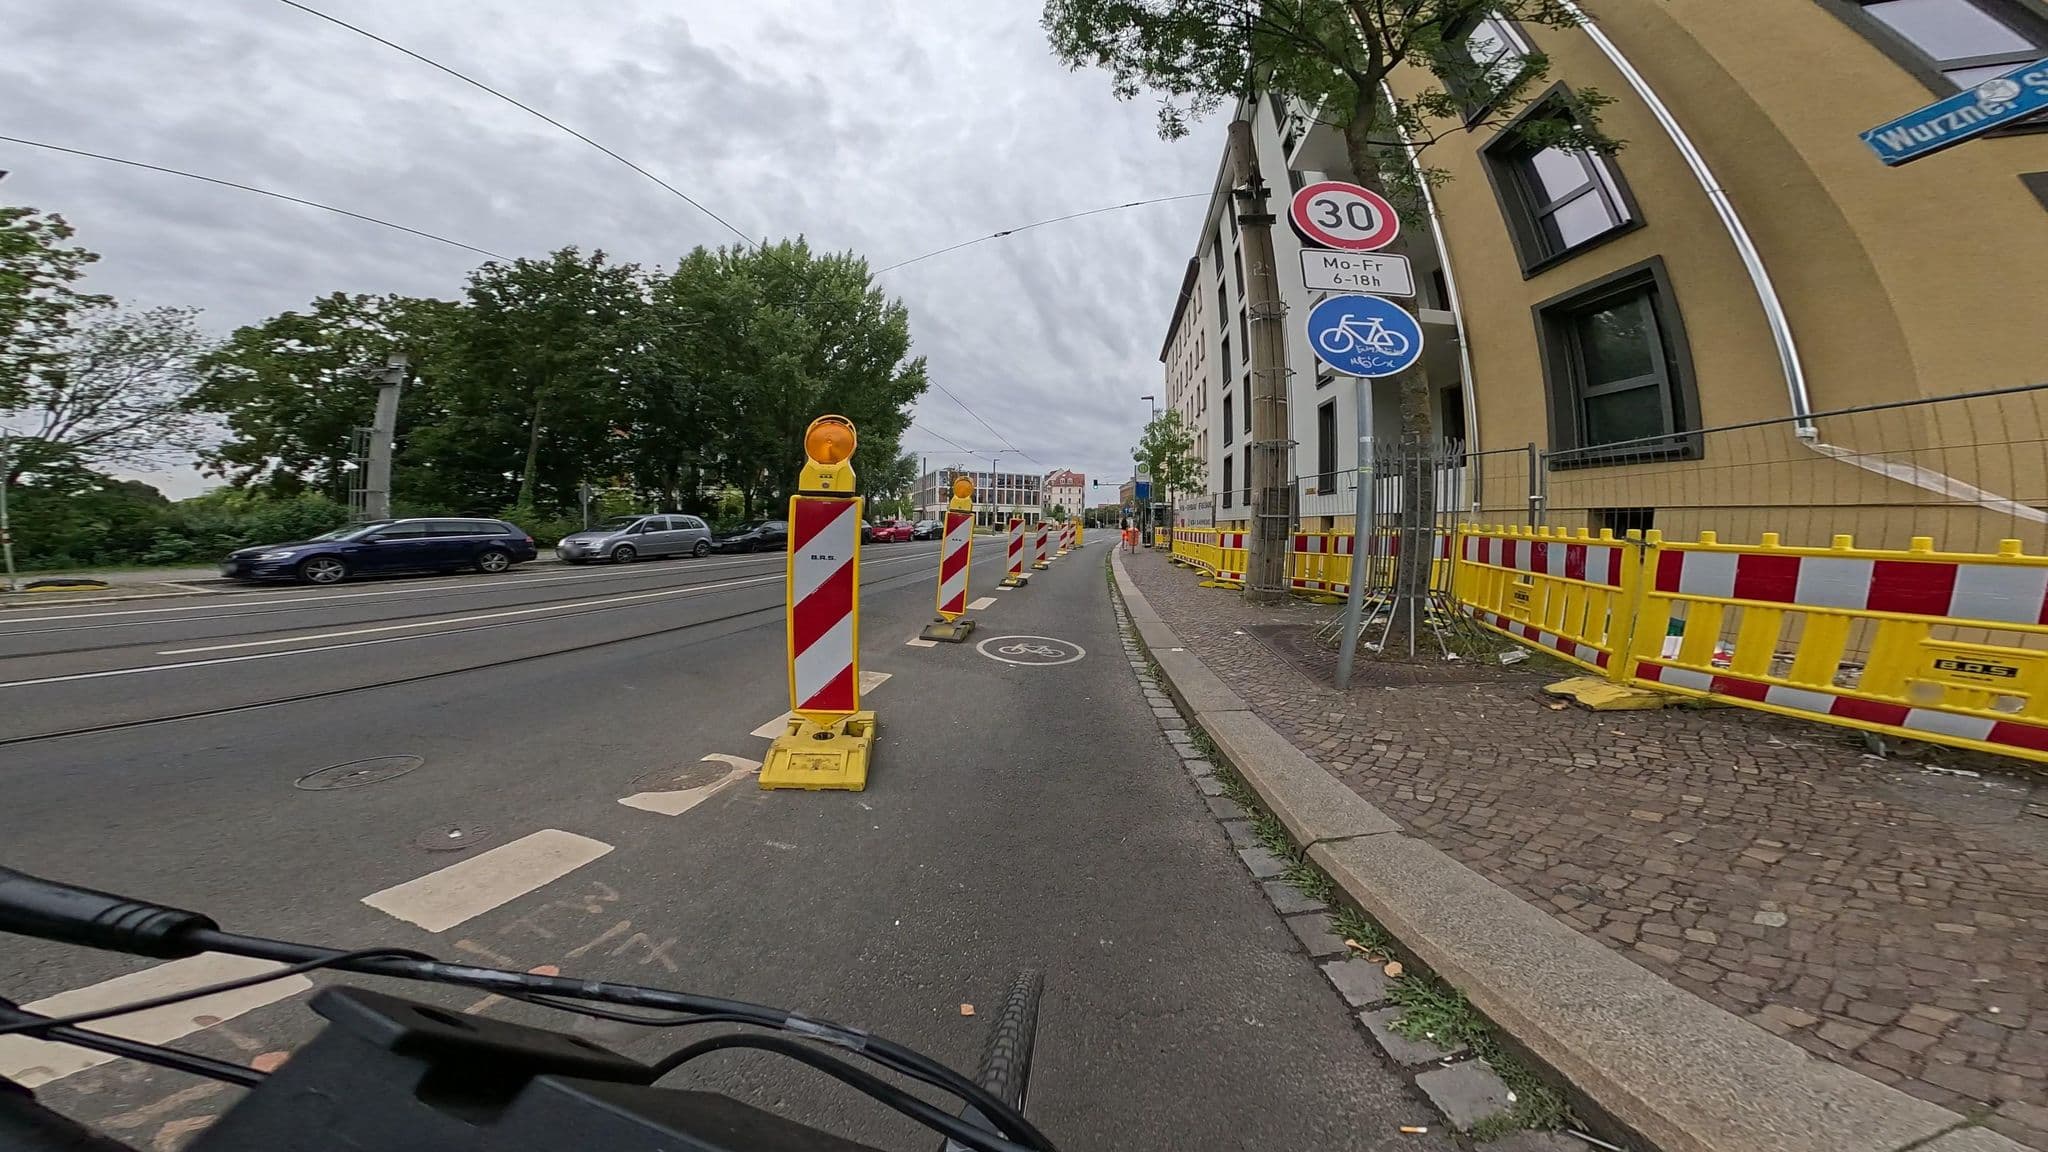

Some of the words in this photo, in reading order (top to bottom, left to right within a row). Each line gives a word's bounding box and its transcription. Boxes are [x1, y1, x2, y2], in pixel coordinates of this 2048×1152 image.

[2023, 68, 2048, 95] S
[1314, 199, 1375, 231] 30
[1323, 256, 1384, 272] Mo-Fr
[1938, 660, 2014, 677] B.A.S.
